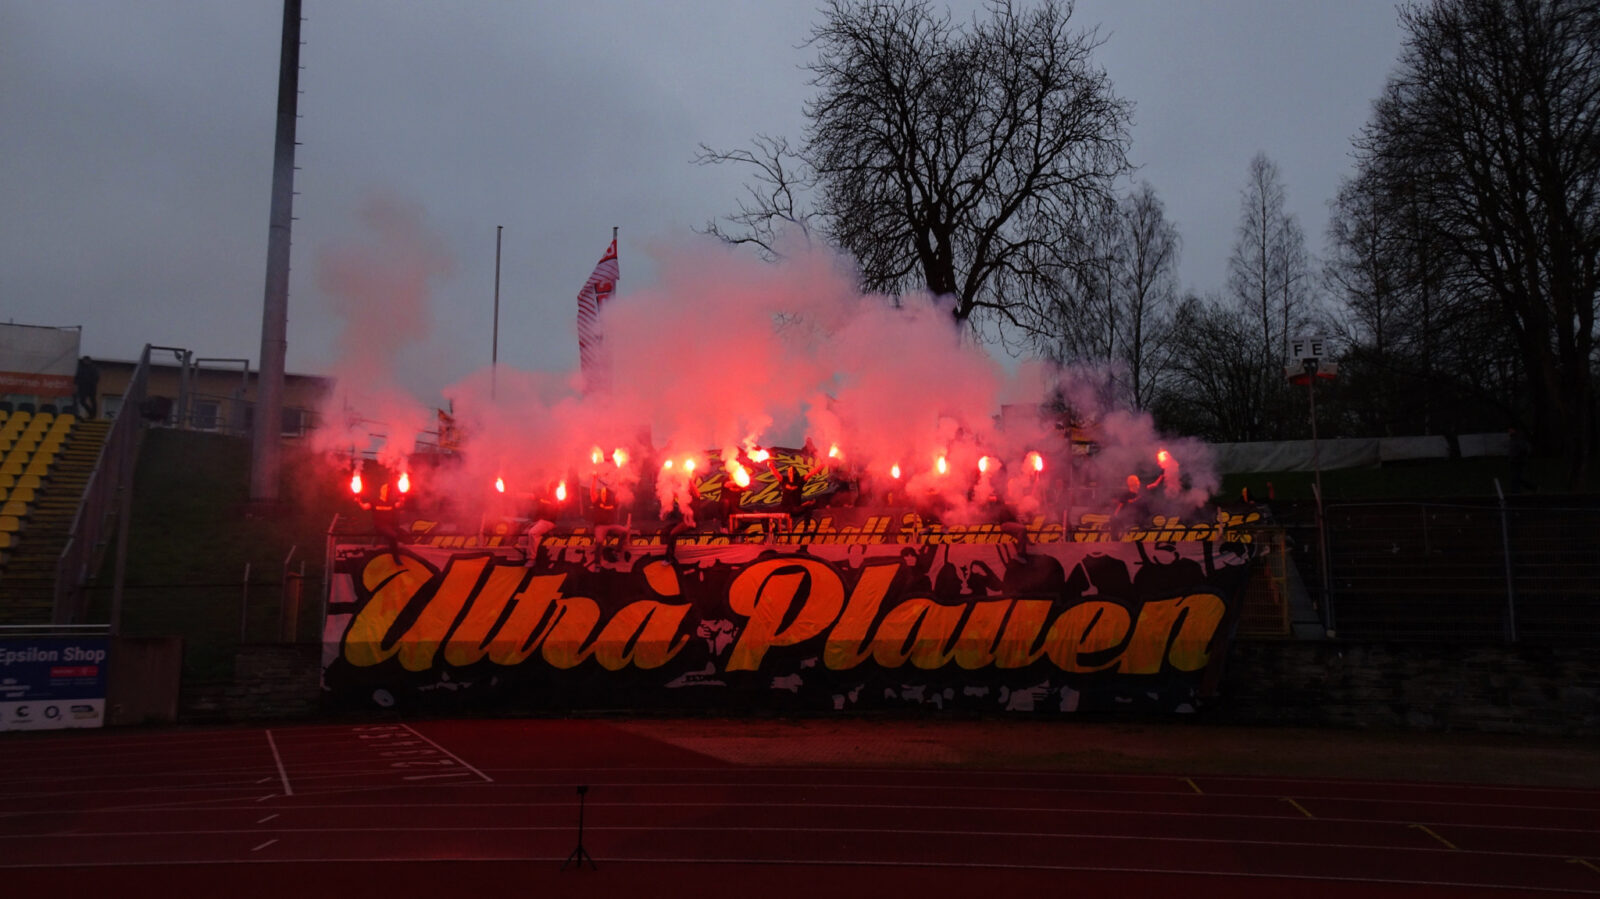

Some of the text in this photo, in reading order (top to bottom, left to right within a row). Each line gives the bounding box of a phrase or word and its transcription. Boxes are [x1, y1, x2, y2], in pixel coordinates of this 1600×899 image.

[1294, 343, 1323, 357] F E
[343, 552, 1229, 676] Ultrà Plauen
[62, 646, 106, 664] Shop
